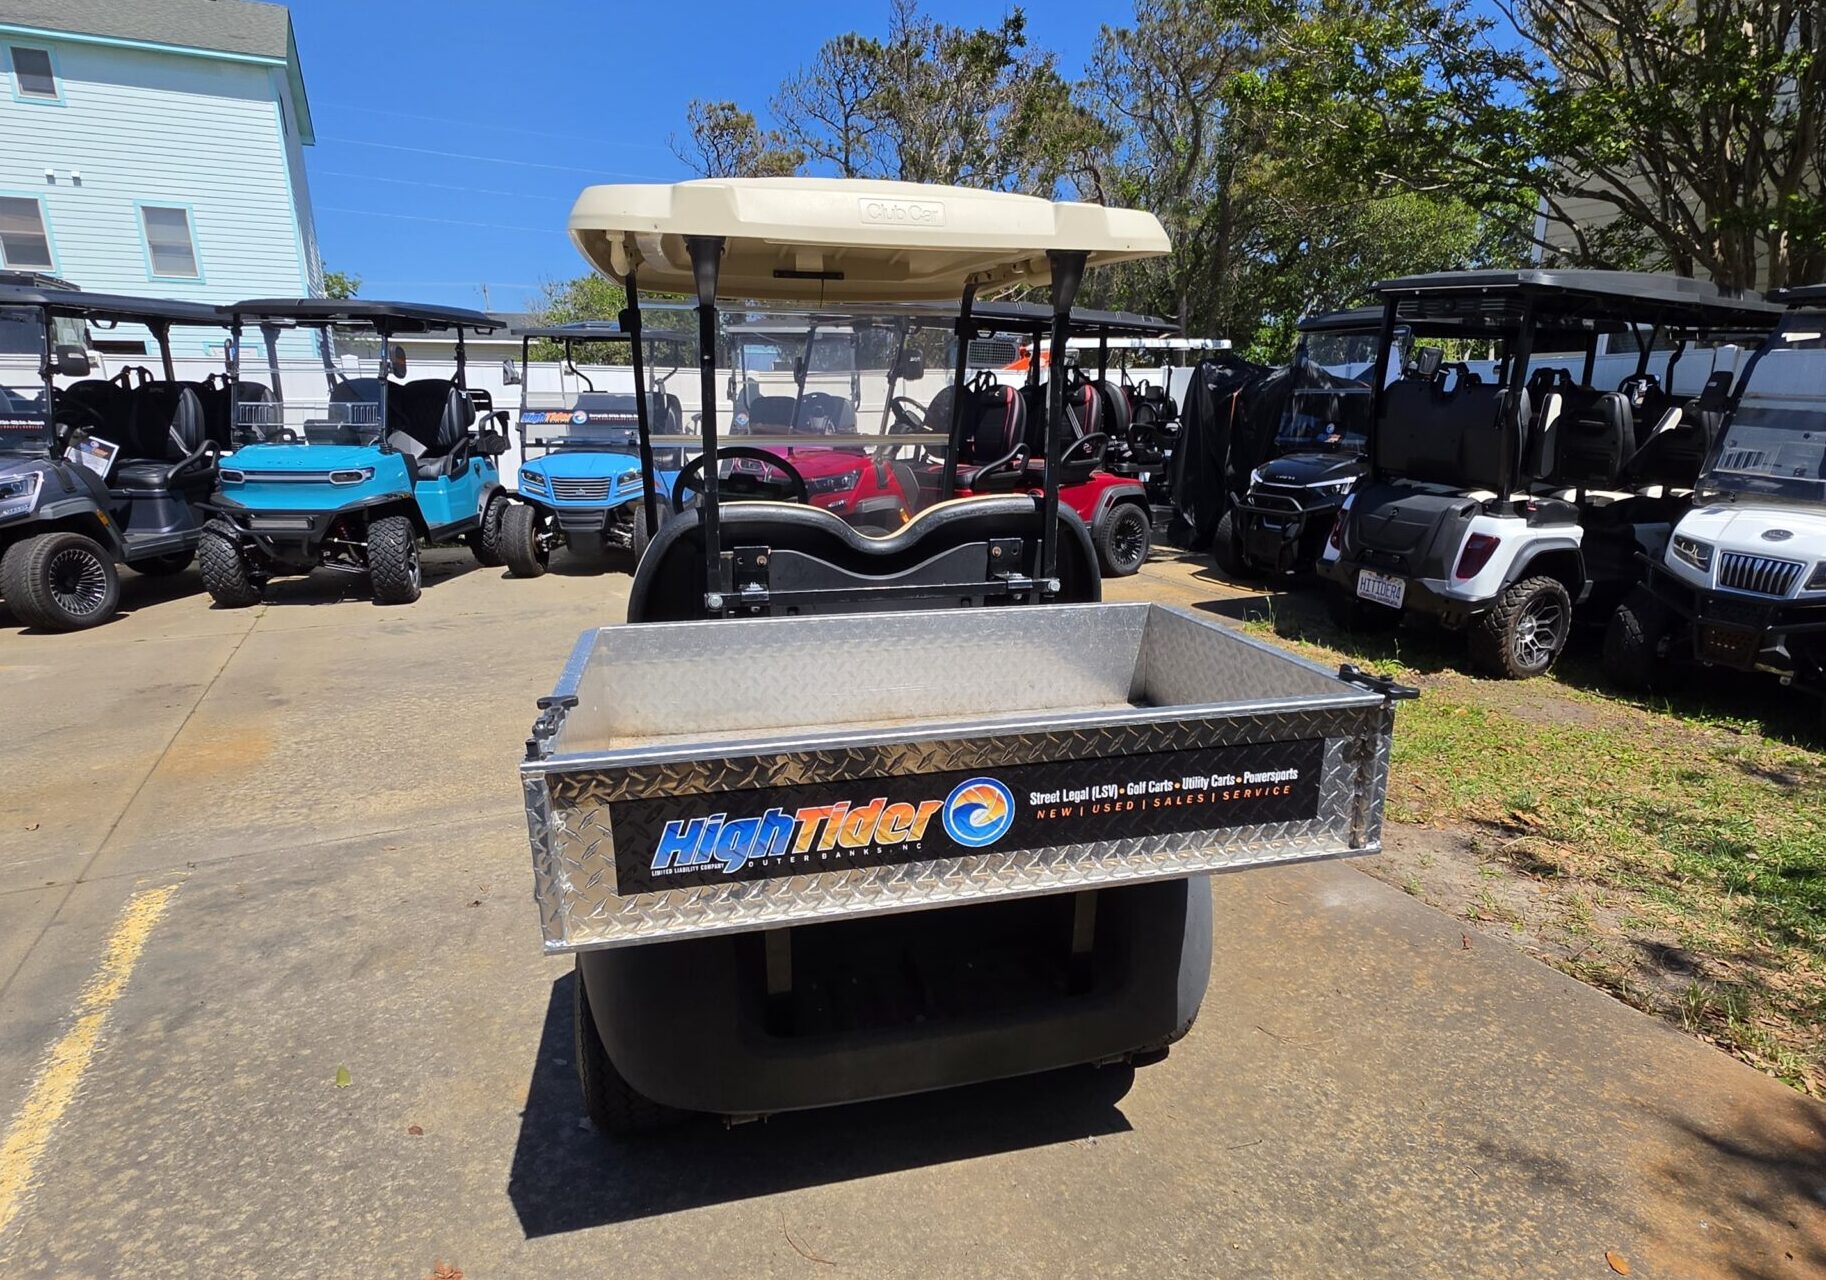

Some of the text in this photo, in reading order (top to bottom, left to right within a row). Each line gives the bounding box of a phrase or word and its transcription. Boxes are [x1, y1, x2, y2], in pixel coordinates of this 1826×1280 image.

[866, 202, 939, 223] Club Car
[1029, 767, 1299, 806] Street Legal (LSV) Golf Carts Utility Carts Powersports
[1036, 785, 1291, 819] NEW USED SALES SERVICE
[748, 855, 810, 868] OUTER
[902, 842, 923, 851] NC
[651, 862, 725, 877] LIMITED LIABILITY COMPANY
